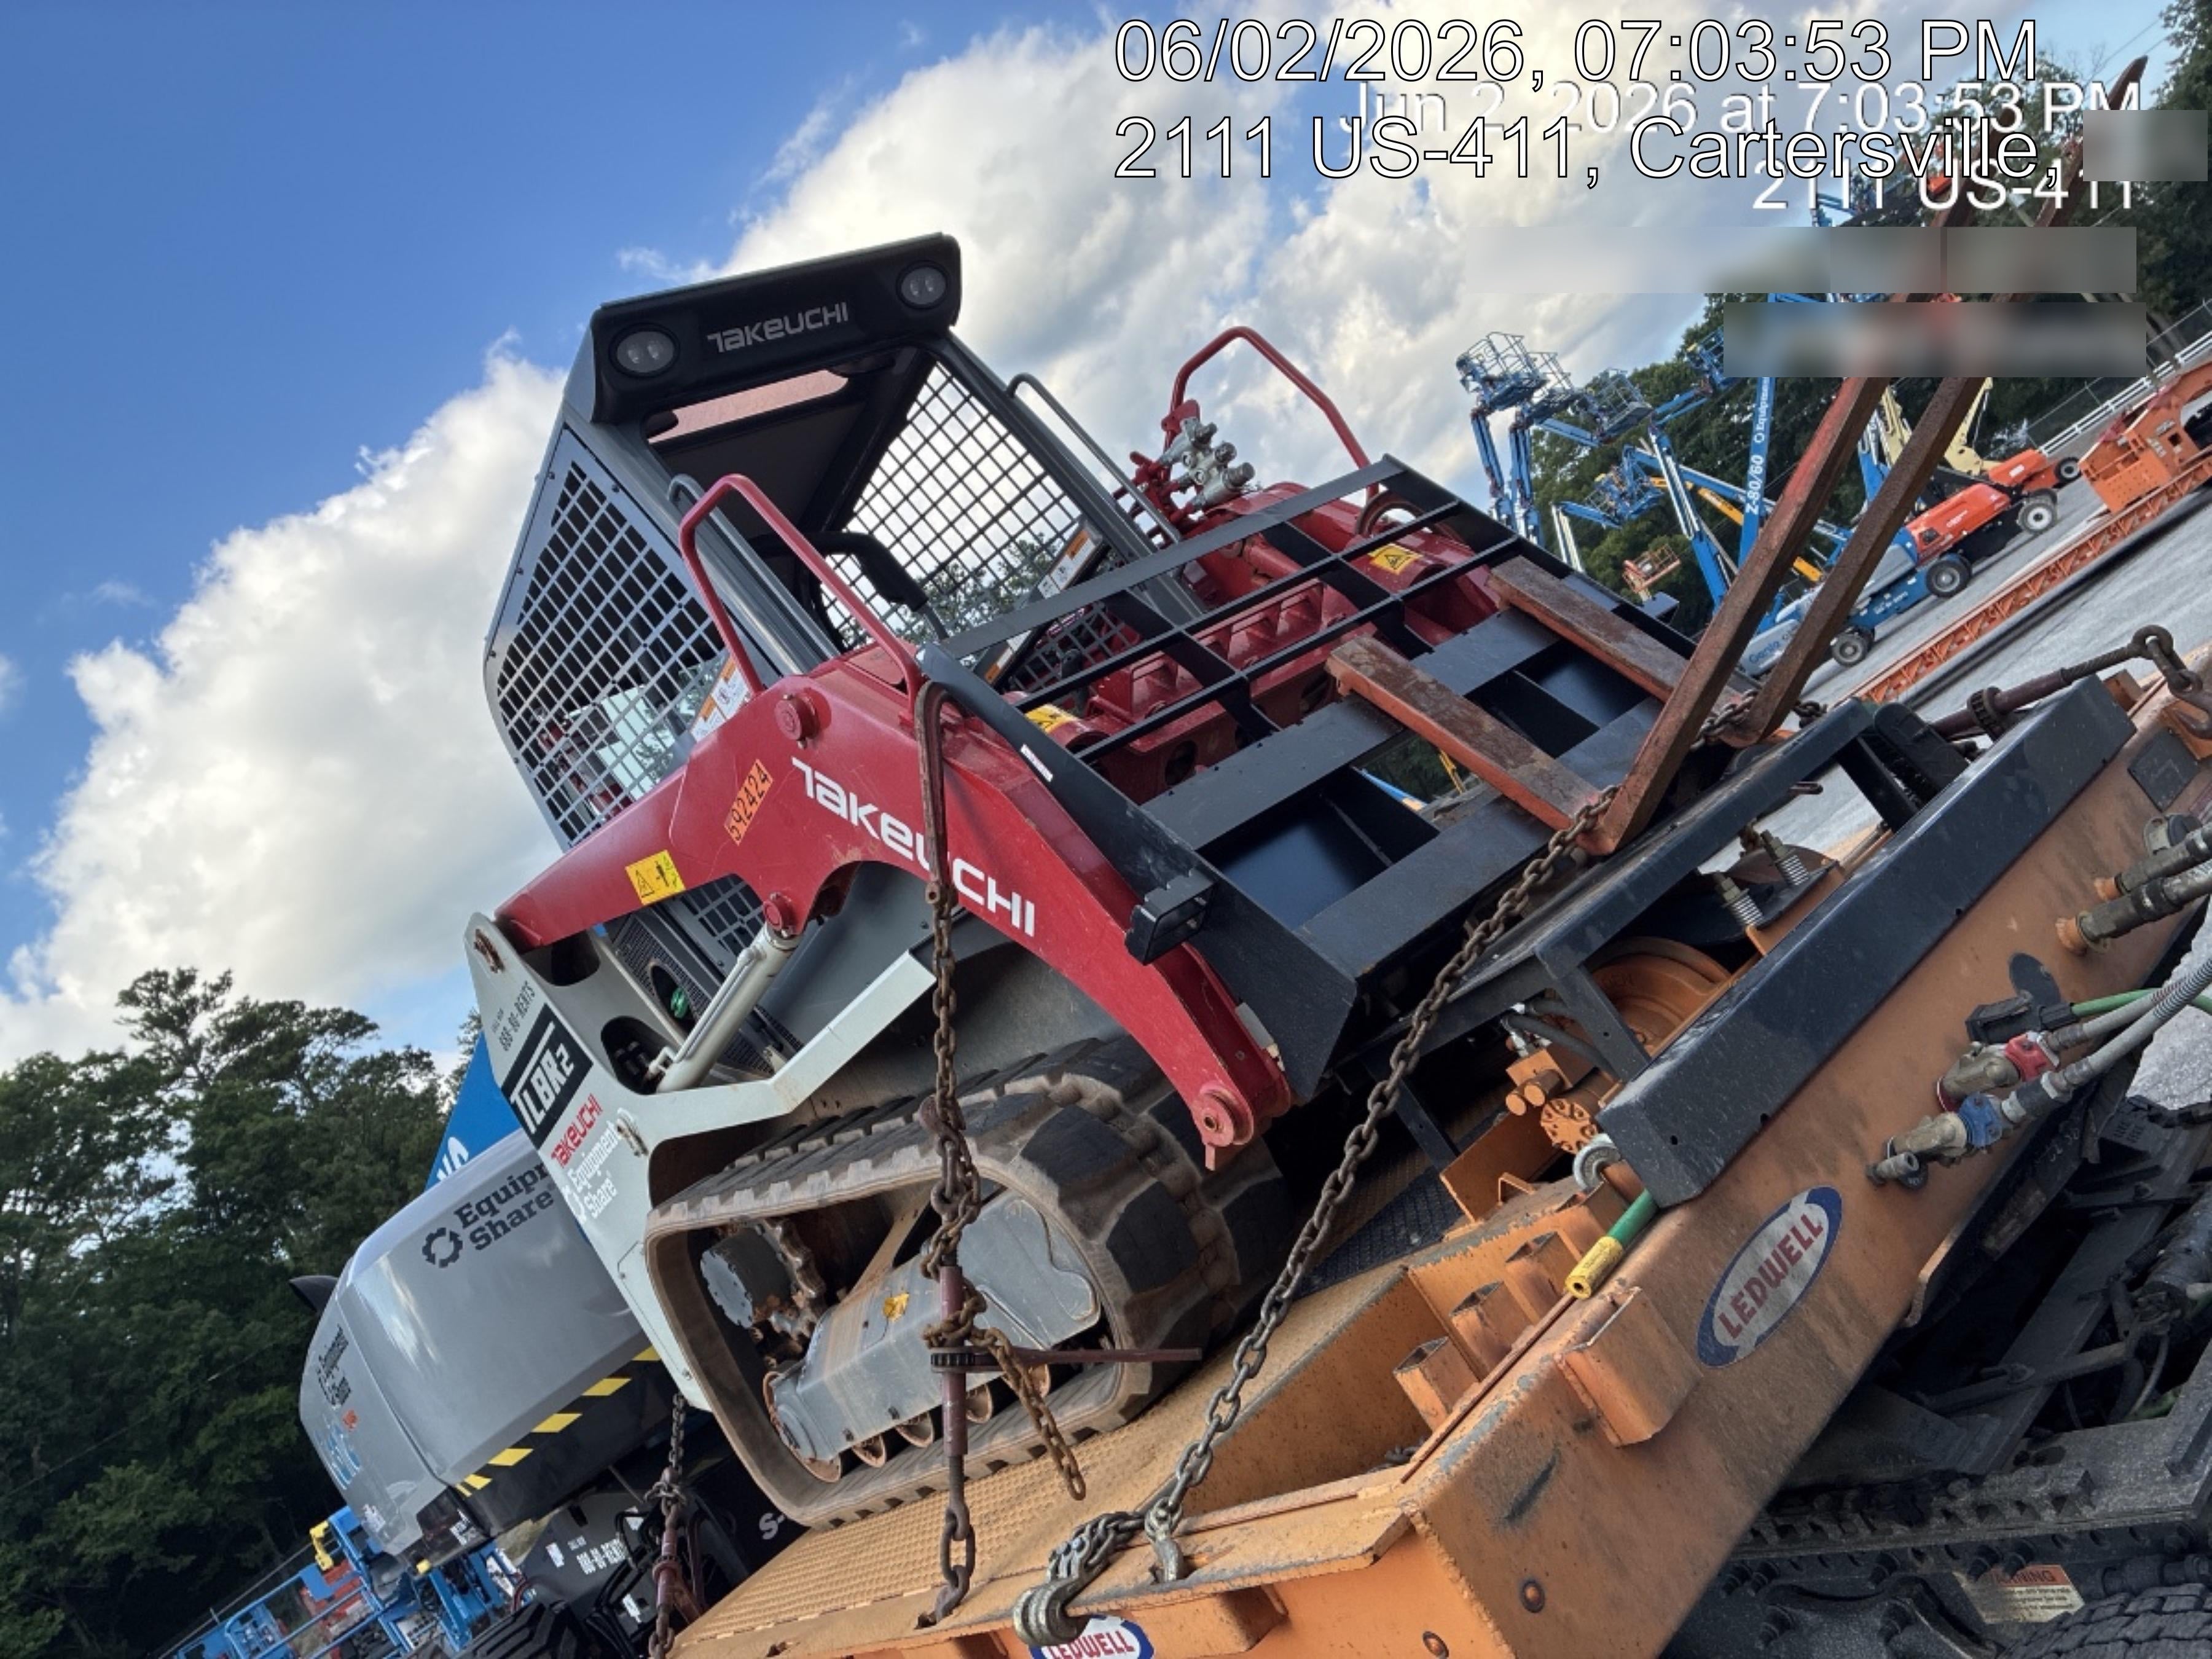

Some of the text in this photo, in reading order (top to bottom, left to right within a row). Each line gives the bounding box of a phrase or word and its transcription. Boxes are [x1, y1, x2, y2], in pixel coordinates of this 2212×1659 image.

[1745, 455, 1764, 516] Z-80/60
[729, 763, 770, 841] 592424
[567, 1120, 622, 1193] Equipment
[1717, 1212, 1824, 1340] LEDWELL
